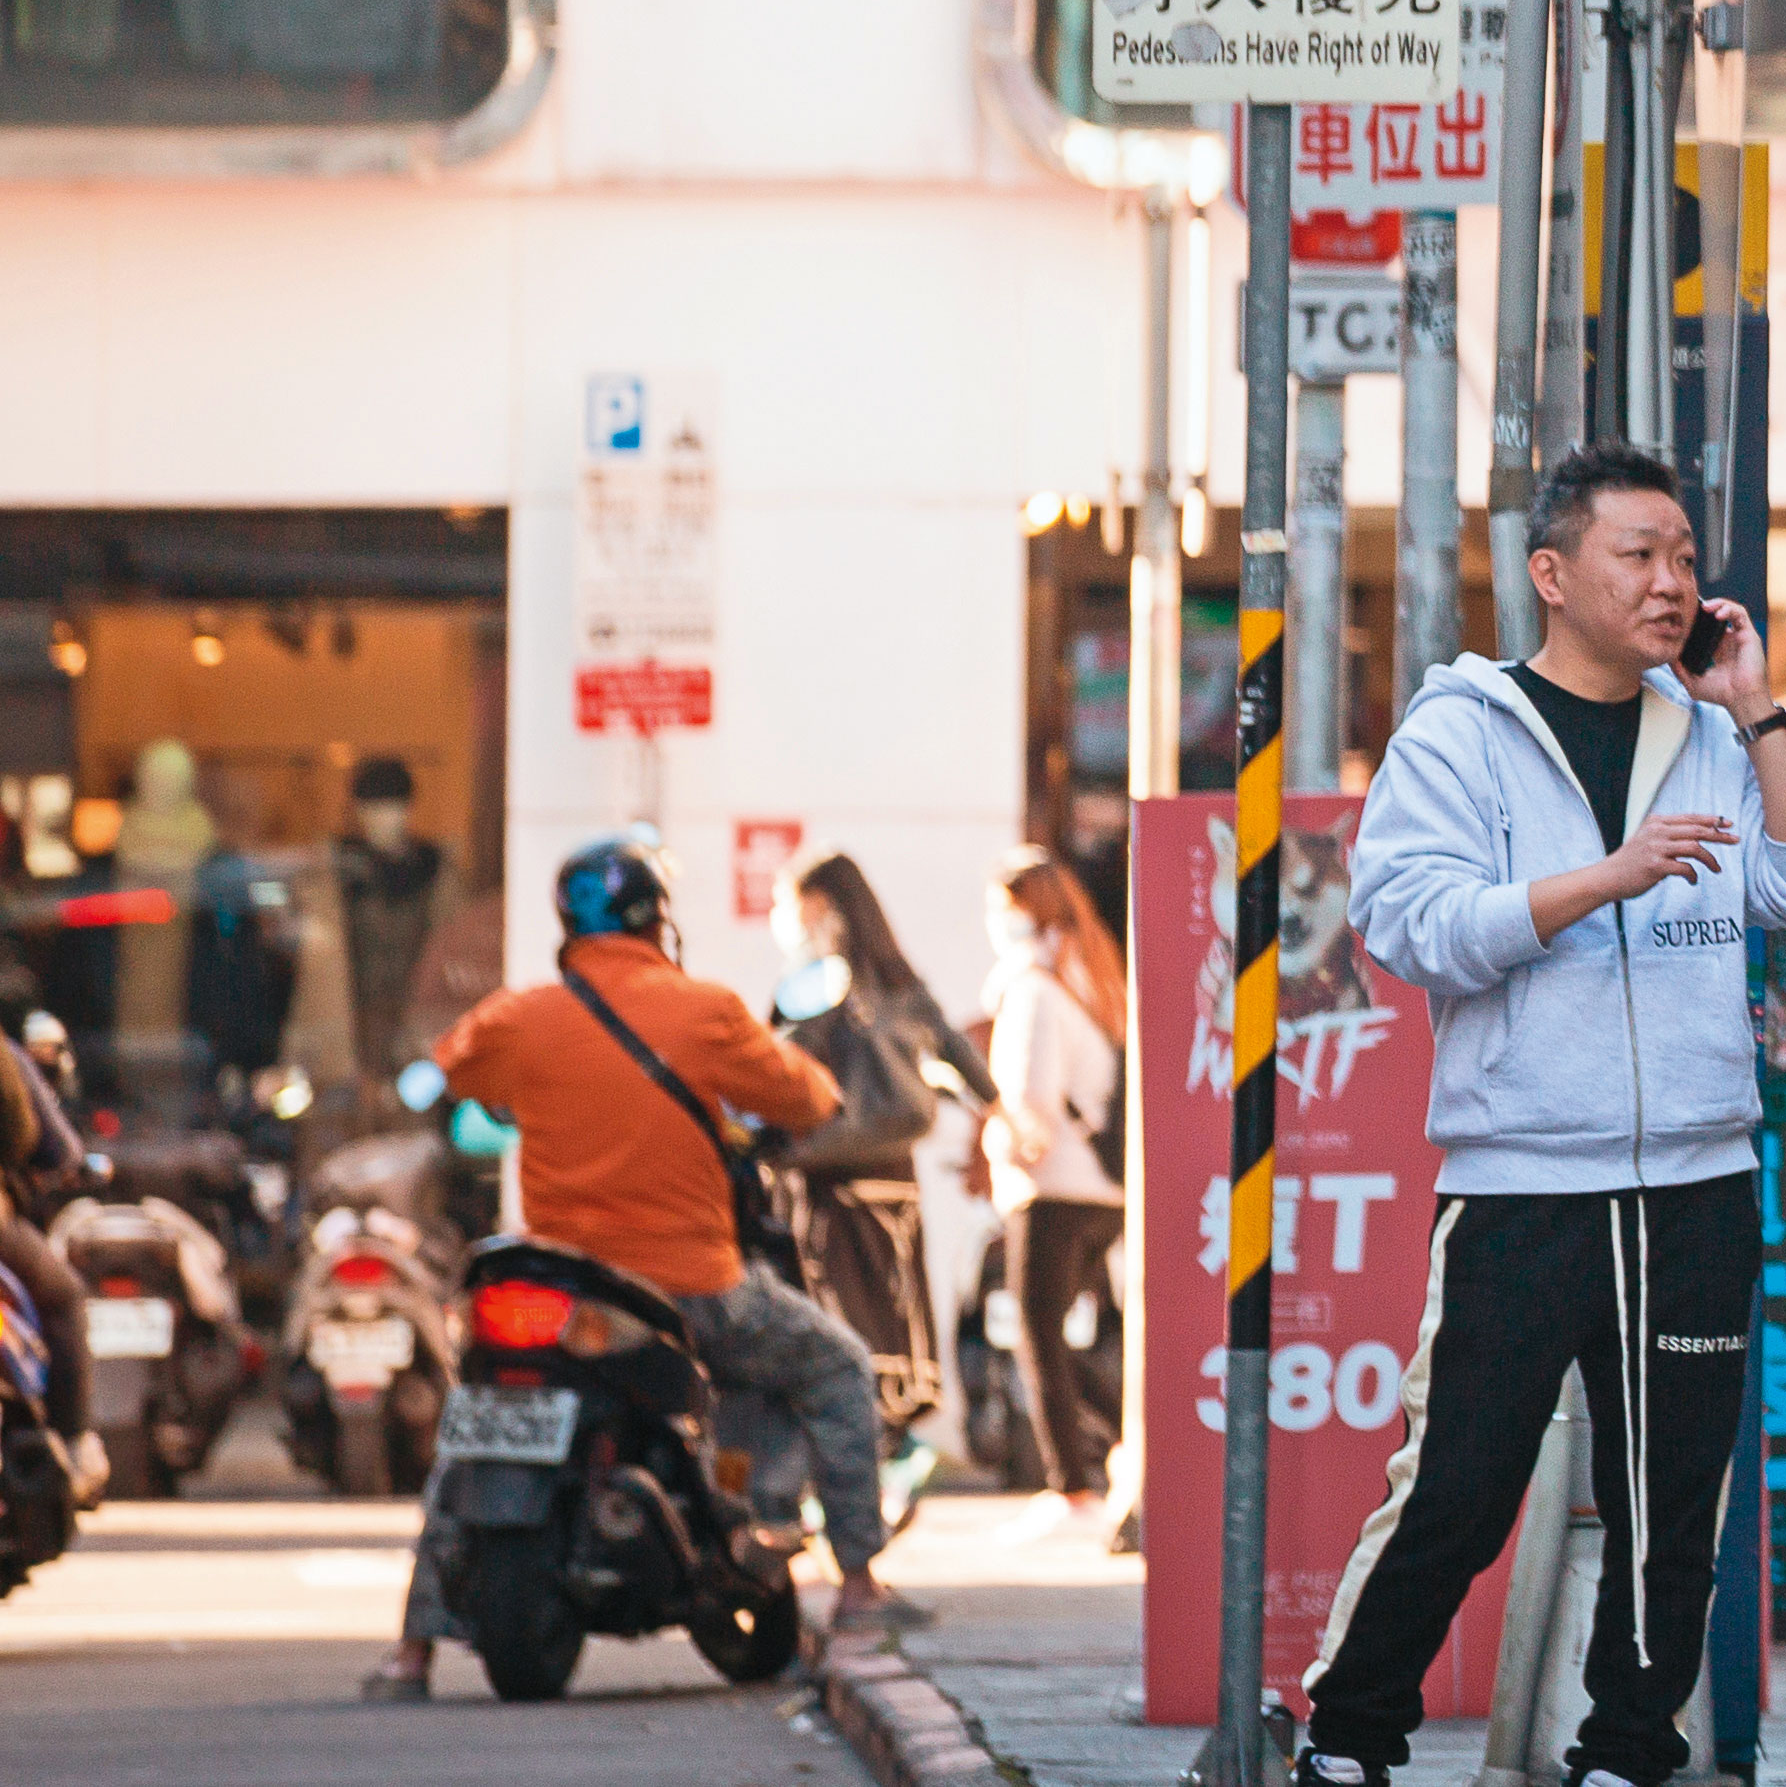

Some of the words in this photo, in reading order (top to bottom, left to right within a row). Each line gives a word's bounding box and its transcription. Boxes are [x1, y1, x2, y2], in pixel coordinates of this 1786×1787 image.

[1113, 30, 1238, 65] Pedesns
[1246, 30, 1299, 65] Have
[1307, 30, 1364, 76] Right
[1370, 30, 1391, 65] of
[1397, 31, 1441, 71] Way
